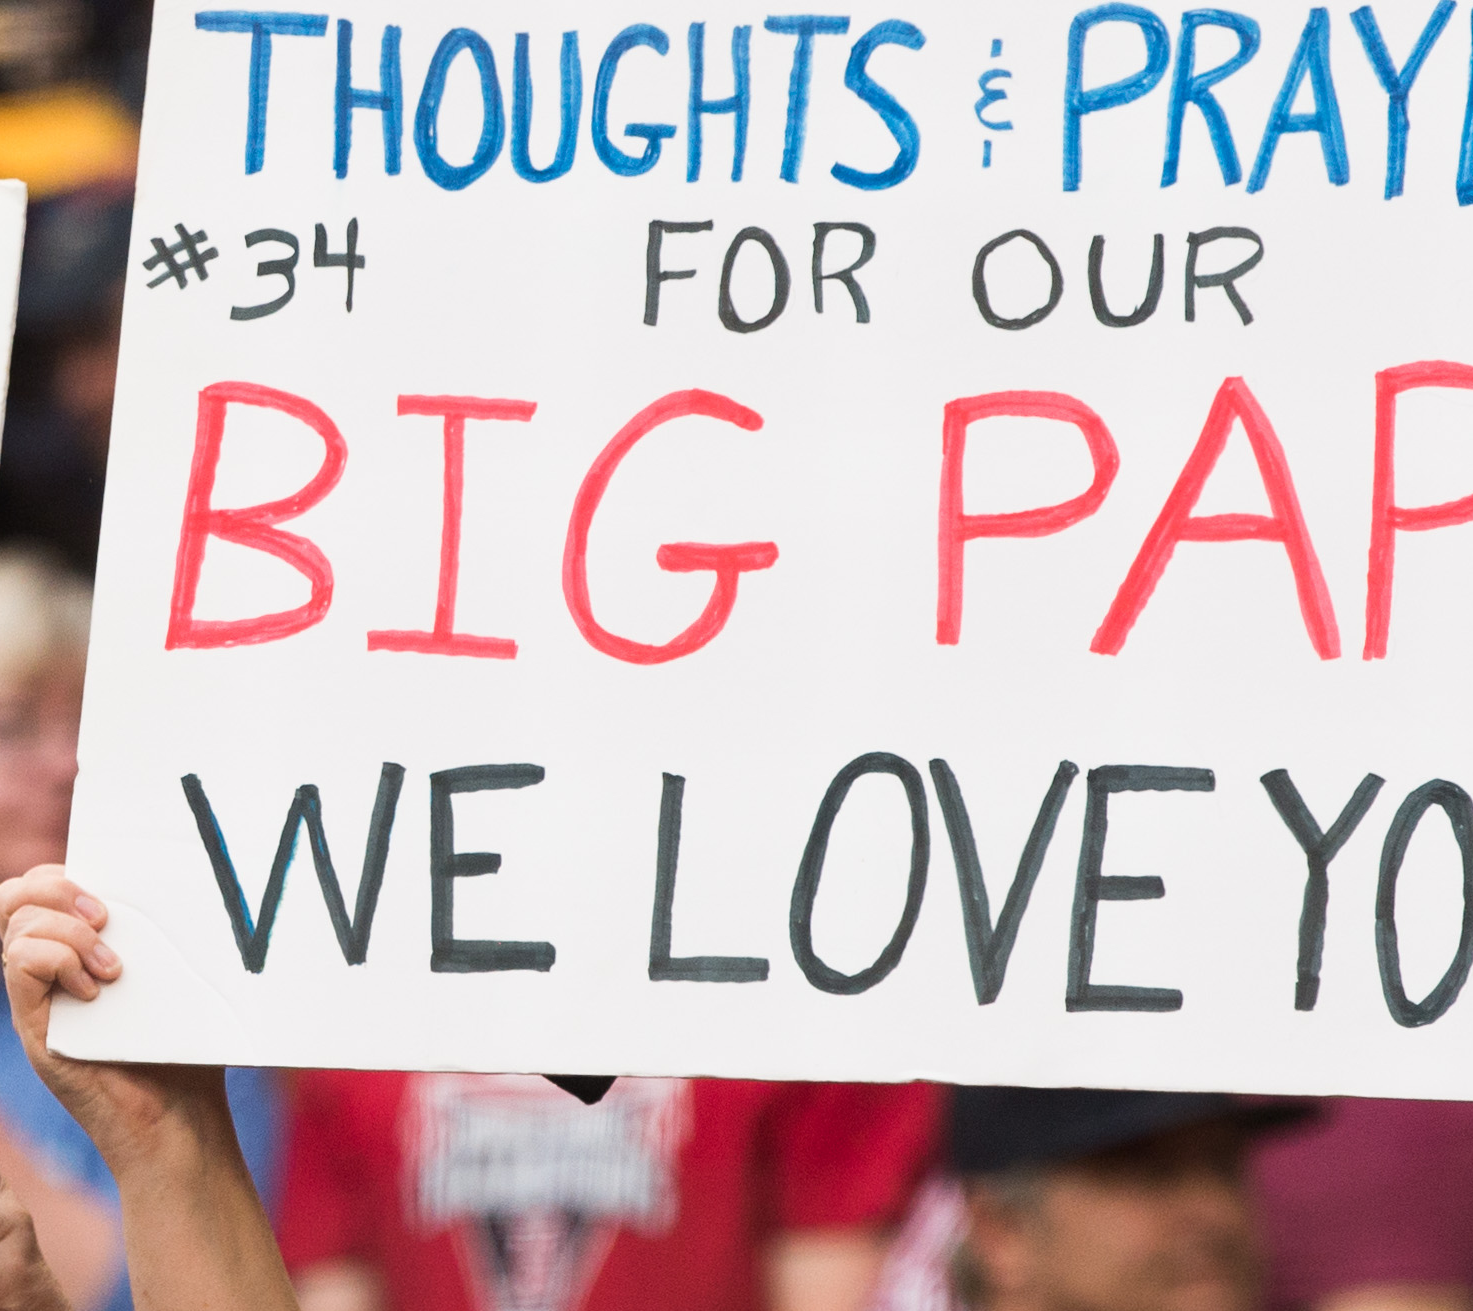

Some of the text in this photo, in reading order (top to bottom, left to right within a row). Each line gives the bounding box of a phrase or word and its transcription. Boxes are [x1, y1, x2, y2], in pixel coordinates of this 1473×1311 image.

[195, 11, 926, 191] THOUGHTS
[141, 218, 364, 320] #34
[644, 221, 1263, 333] FOR OUR
[165, 381, 779, 666] BIG
[181, 763, 555, 973] WE
[649, 752, 1215, 1012] LOVE
